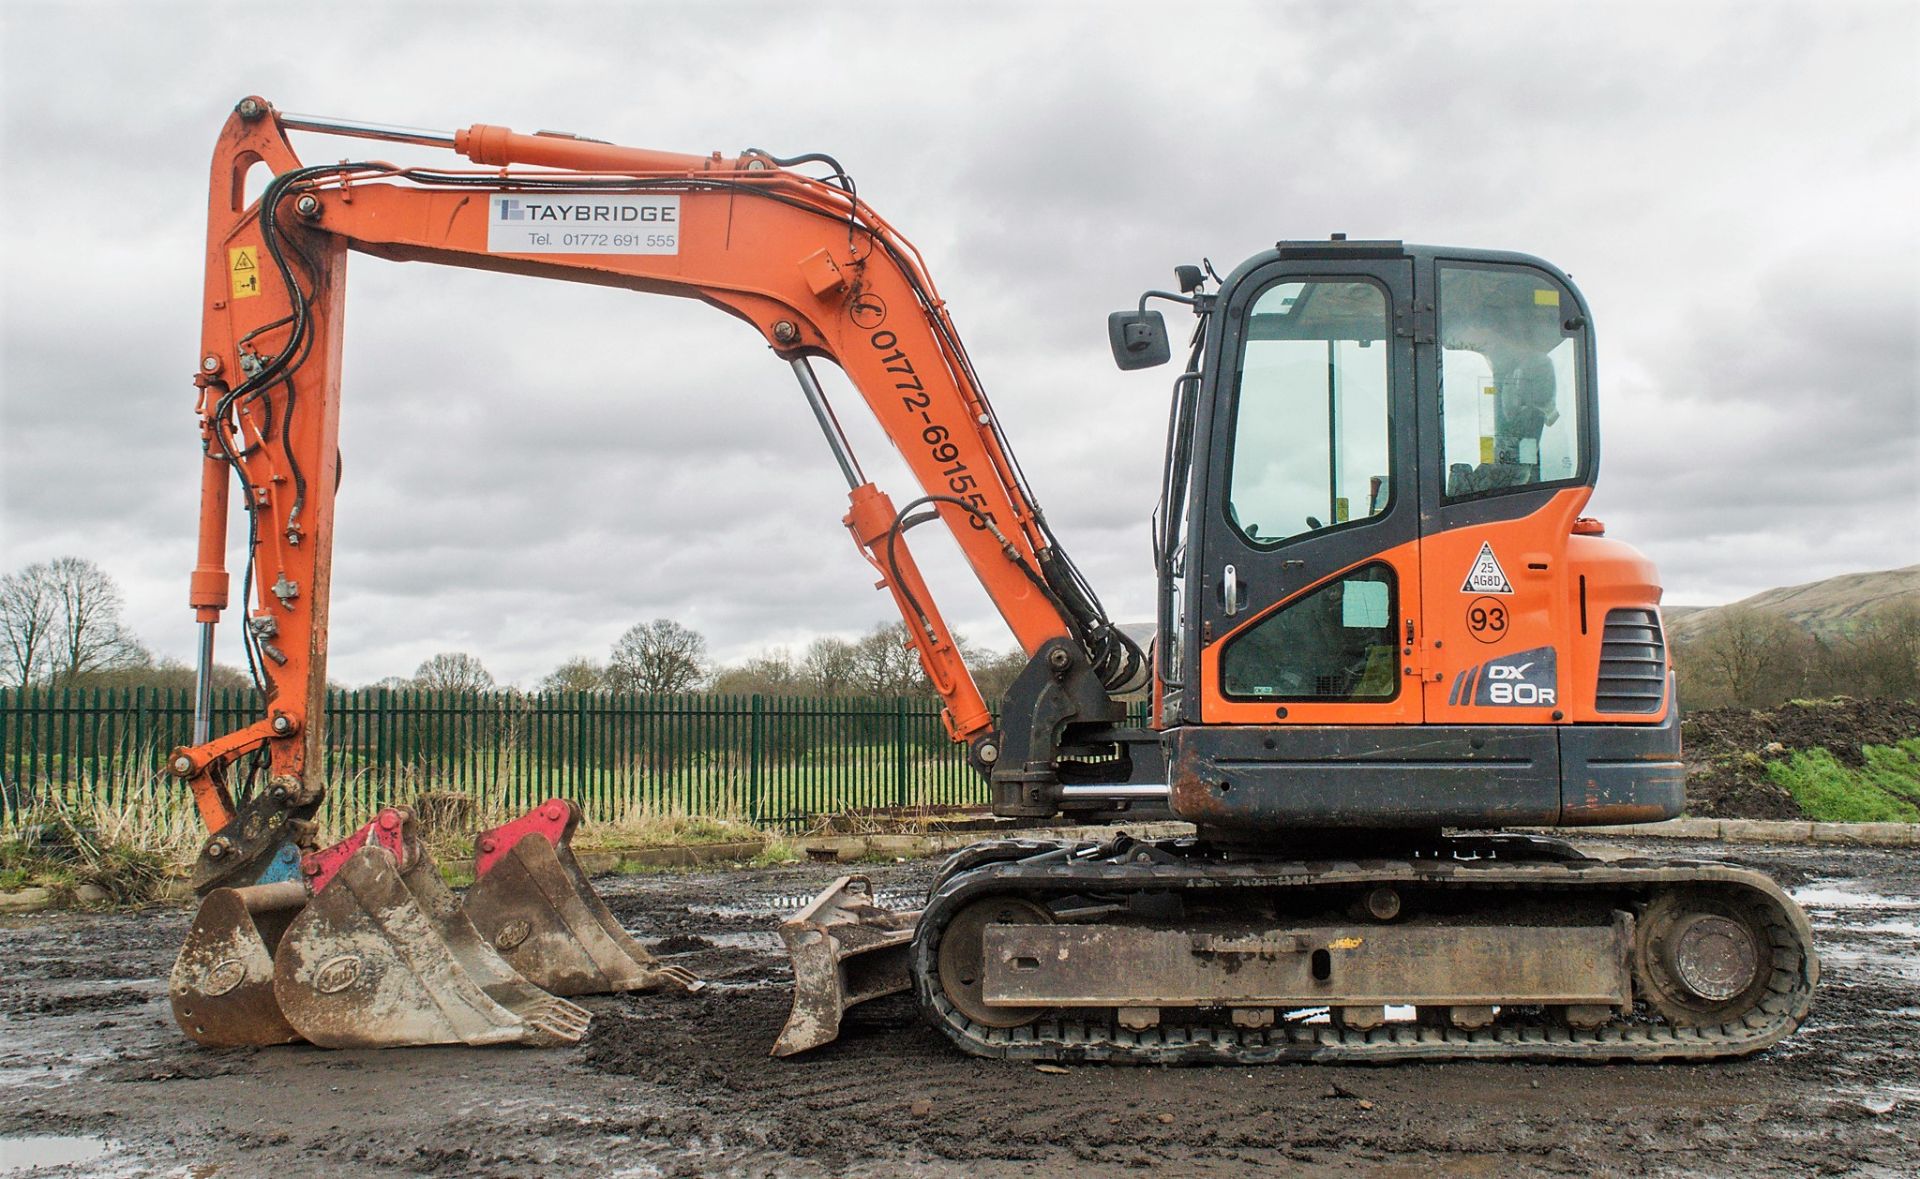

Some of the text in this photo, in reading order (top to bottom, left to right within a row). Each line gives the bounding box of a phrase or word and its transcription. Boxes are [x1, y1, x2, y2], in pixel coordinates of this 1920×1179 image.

[526, 205, 676, 222] TAYBRIDGE
[528, 233, 675, 248] Tel. 01772 691 555
[1480, 562, 1494, 574] 25
[1470, 607, 1505, 631] 93
[1488, 662, 1535, 680] DX
[1490, 682, 1556, 704] 80R
